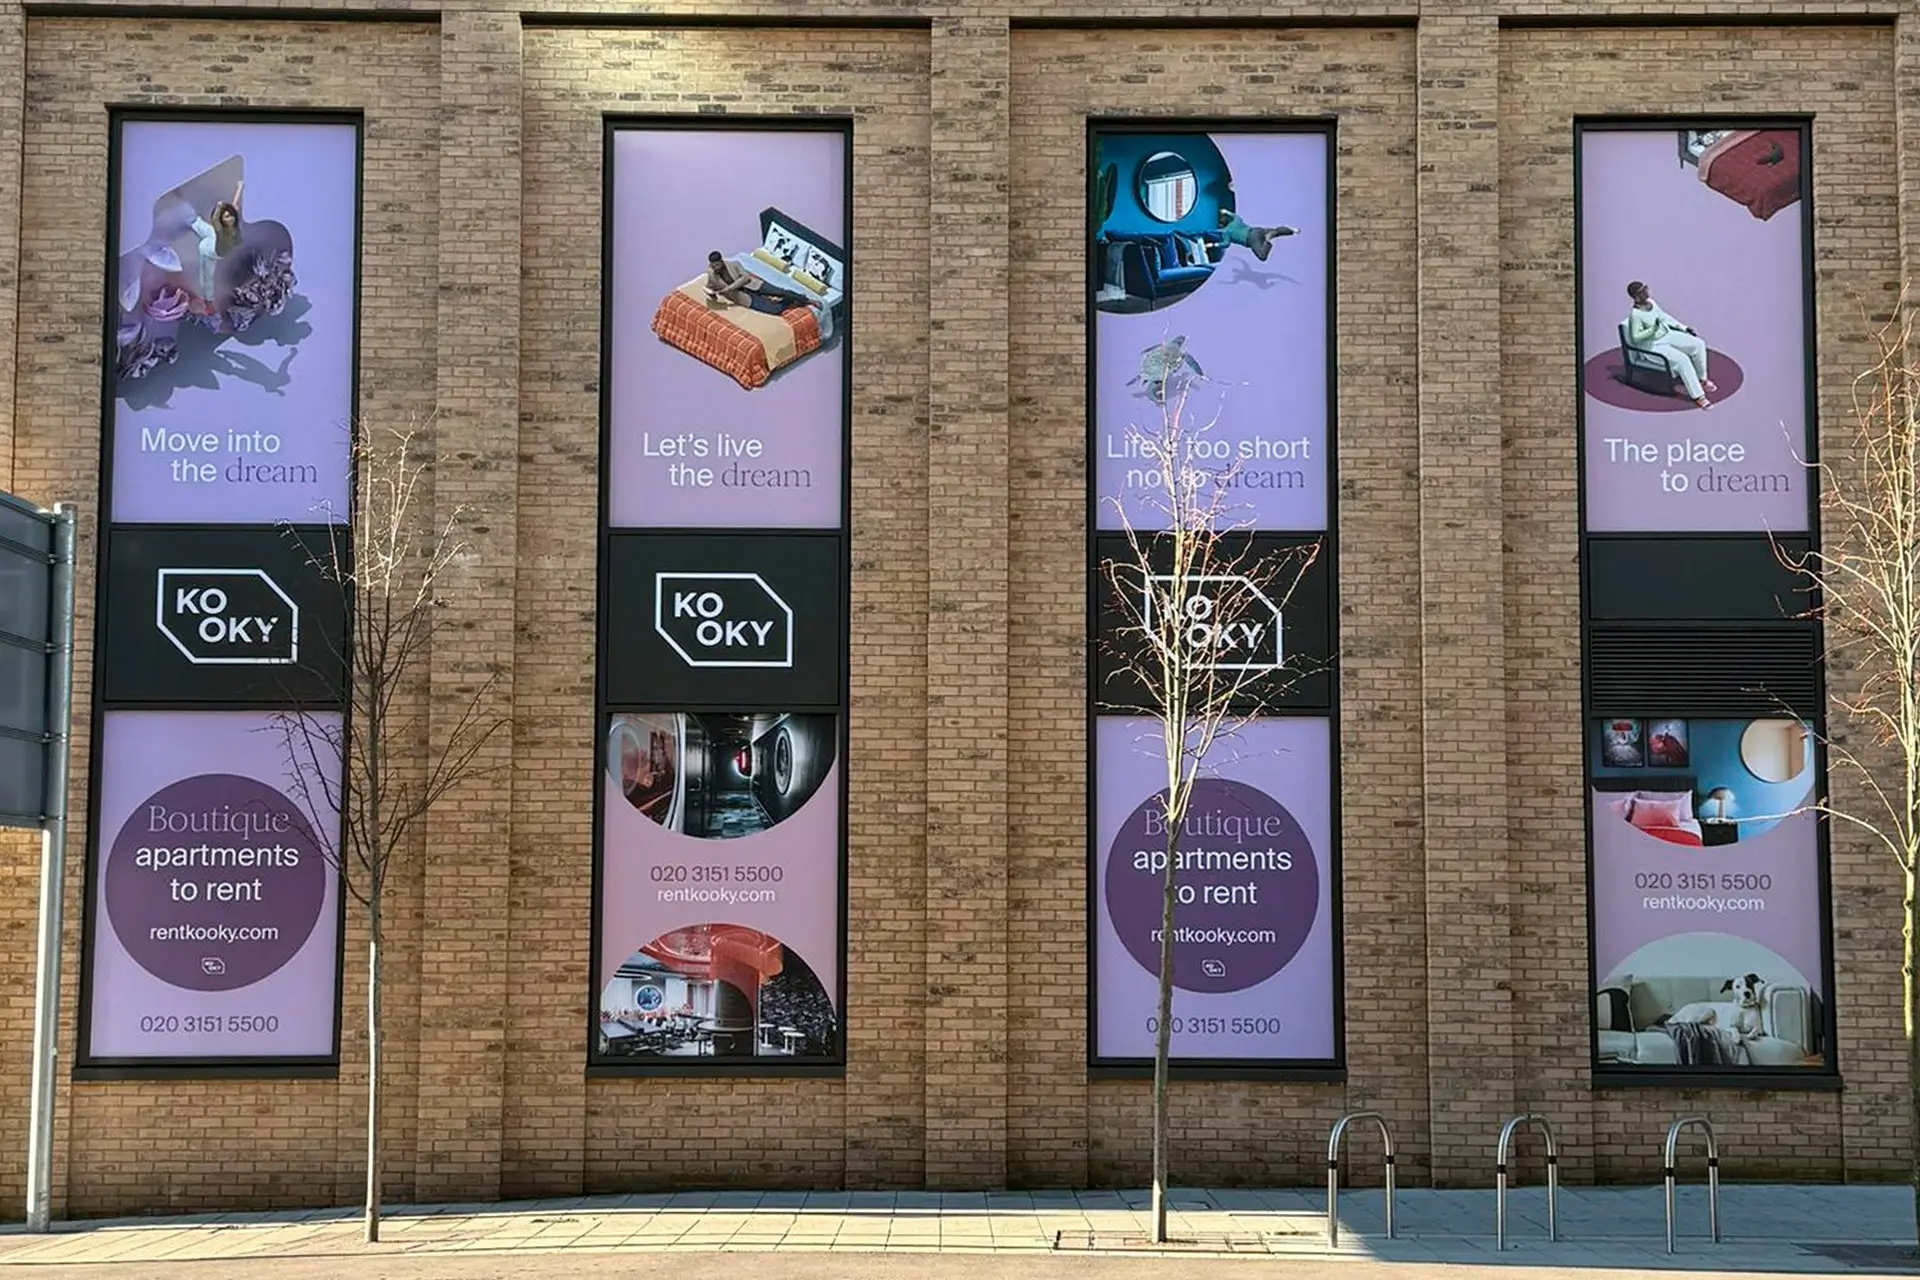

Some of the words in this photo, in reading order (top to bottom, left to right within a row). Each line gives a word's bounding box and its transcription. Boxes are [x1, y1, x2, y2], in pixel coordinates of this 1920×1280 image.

[141, 427, 219, 453] Move
[227, 428, 281, 453] into
[643, 432, 709, 457] Let's
[717, 432, 763, 457] live
[1185, 435, 1231, 459] too
[1239, 435, 1310, 459] short
[1603, 438, 1658, 462] The
[1667, 437, 1745, 467] place
[171, 458, 218, 483] the
[225, 456, 318, 484] dream
[668, 462, 714, 487] the
[721, 461, 812, 488] dream
[1127, 466, 1172, 489] no
[1214, 462, 1305, 489] dream
[1660, 469, 1689, 492] to
[1696, 466, 1790, 493] dream
[176, 588, 228, 615] KO
[674, 592, 724, 618] KO
[198, 616, 279, 643] OKY
[696, 620, 775, 647] OKY
[148, 804, 291, 841] Boutique
[135, 843, 300, 872] apartments
[1133, 847, 1293, 876] apartments
[650, 865, 688, 882] 020
[691, 865, 729, 882] 3151
[733, 866, 784, 883] 5500
[1634, 872, 1673, 889] 020
[1677, 873, 1716, 890] 3151
[1721, 873, 1772, 890] 5500
[170, 878, 198, 901] to
[207, 878, 262, 901] rent
[658, 887, 776, 905] rentkooky.com
[1174, 882, 1196, 905] o
[1203, 881, 1258, 905] rent
[1643, 895, 1765, 913] rentkooky.com
[150, 924, 279, 944] rentkooky.com
[140, 1015, 179, 1033] 020
[184, 1015, 222, 1033] 3151
[228, 1015, 279, 1033] 5500
[1146, 1017, 1184, 1034] 00
[1188, 1017, 1226, 1034] 3151
[1231, 1018, 1281, 1034] 5500
